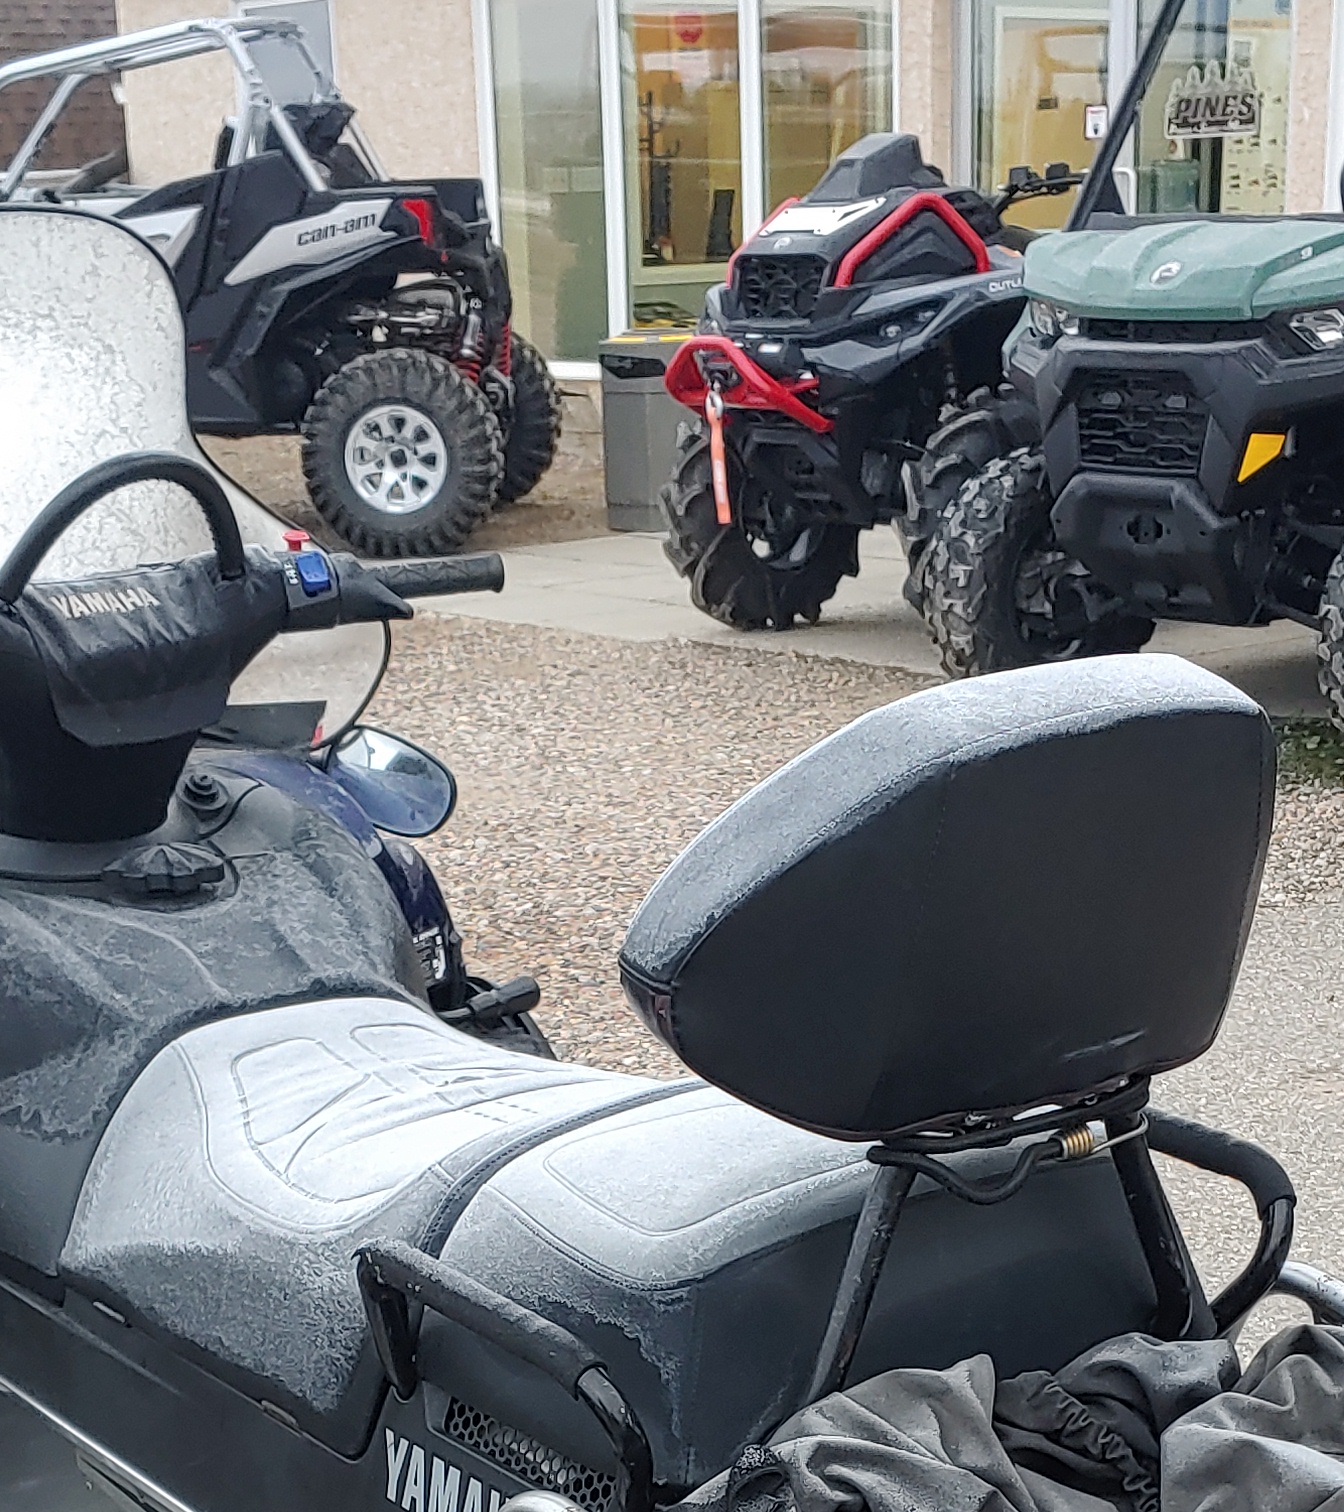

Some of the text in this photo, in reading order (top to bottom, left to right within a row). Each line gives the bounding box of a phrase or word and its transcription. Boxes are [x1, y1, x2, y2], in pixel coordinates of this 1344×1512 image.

[1176, 94, 1254, 121] PINES
[298, 213, 376, 246] can-am
[48, 586, 161, 619] YAMAHA
